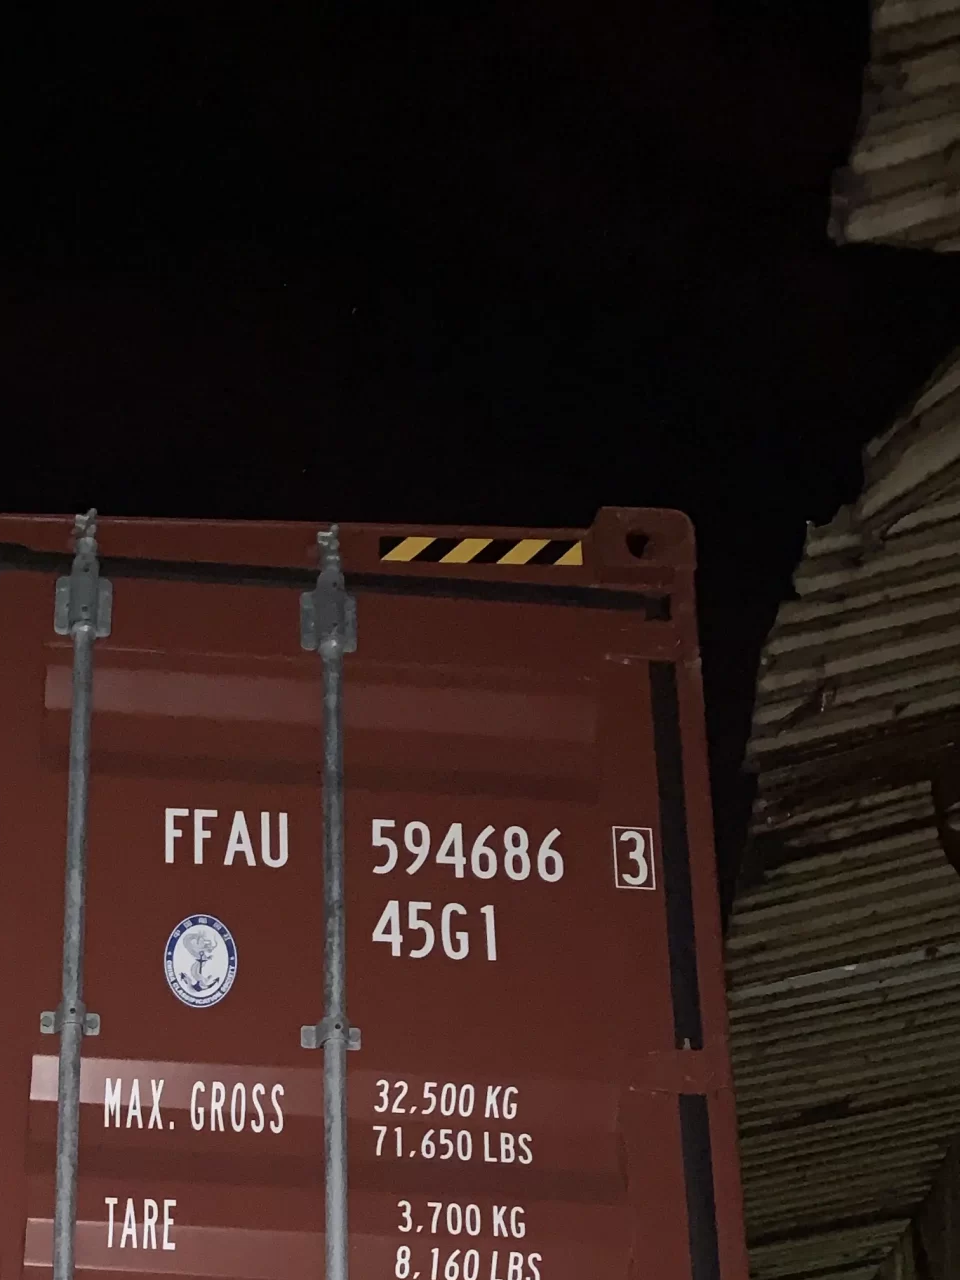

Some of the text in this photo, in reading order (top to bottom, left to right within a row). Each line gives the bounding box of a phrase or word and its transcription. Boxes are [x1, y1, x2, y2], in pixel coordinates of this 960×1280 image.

[164, 807, 649, 886] FFAU 594686 3
[372, 900, 497, 961] 45G1
[104, 1077, 285, 1134] MAX. GROSS
[373, 1079, 519, 1120] 32,500 KG
[372, 1125, 533, 1165] 71,650 LBS
[104, 1197, 177, 1250] TARE
[397, 1200, 526, 1239] 3,700 KG
